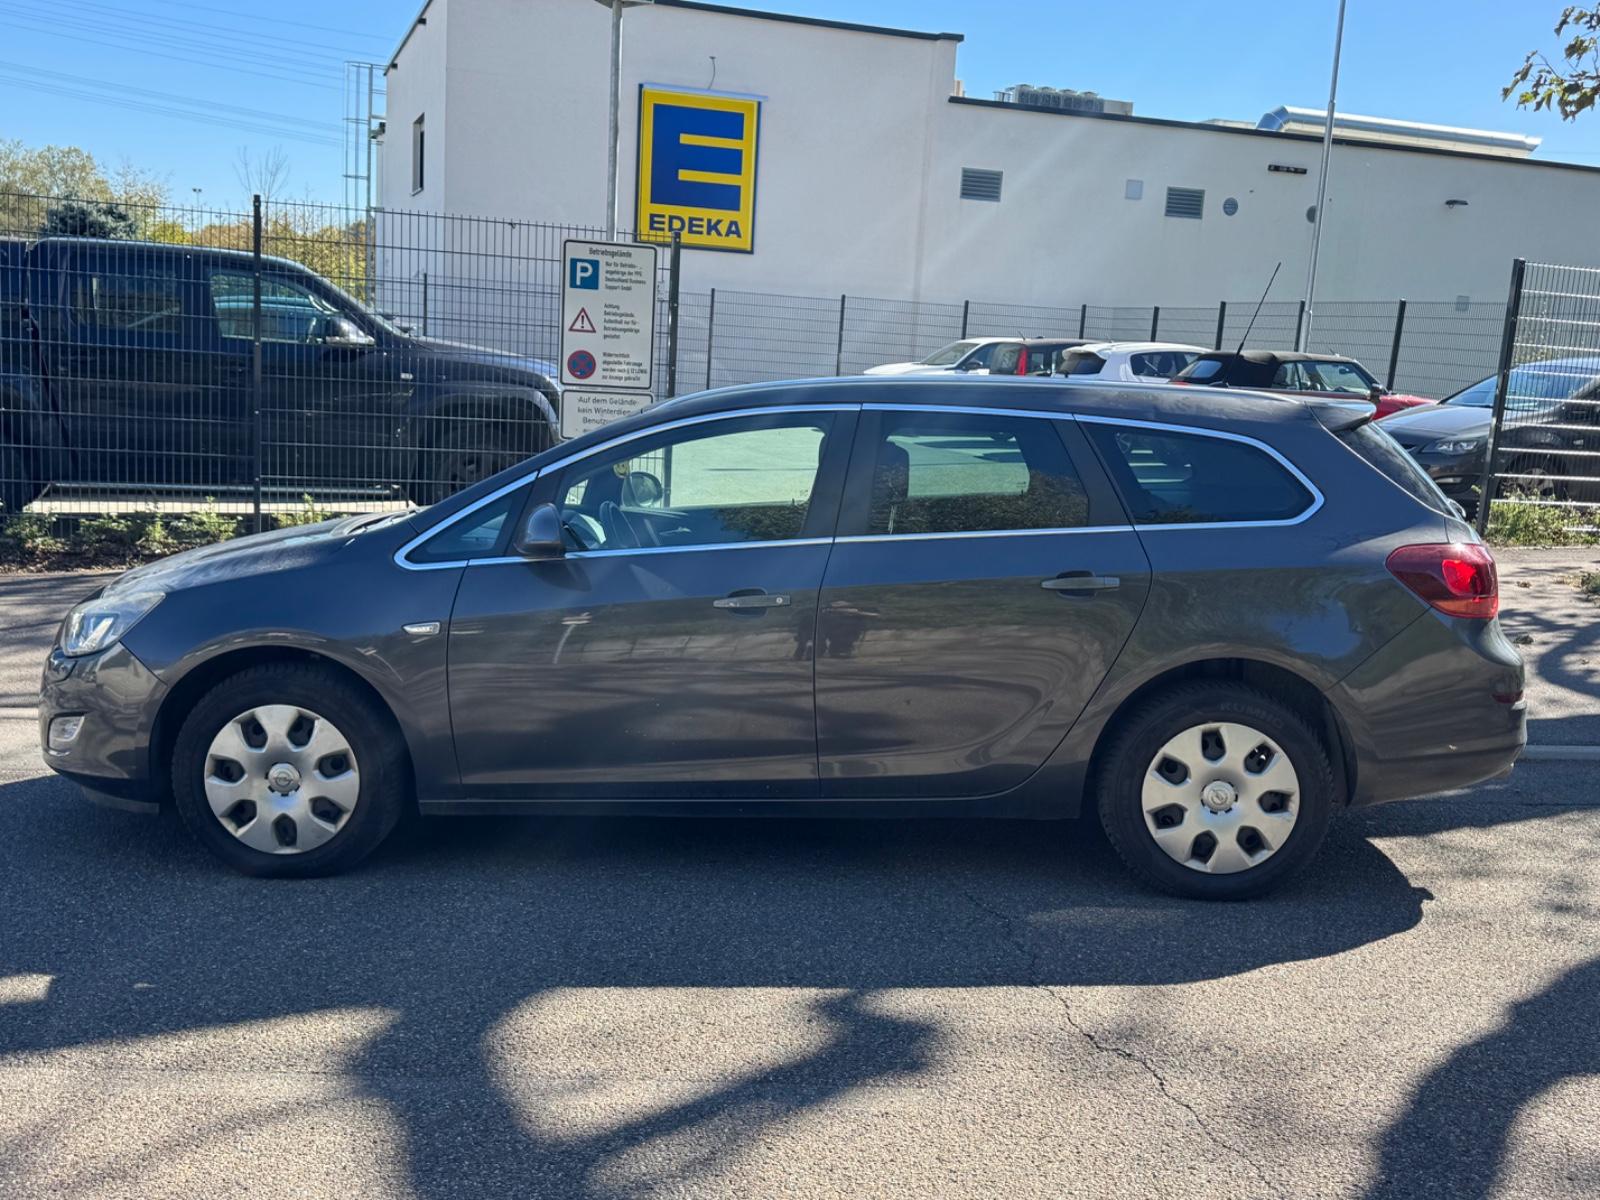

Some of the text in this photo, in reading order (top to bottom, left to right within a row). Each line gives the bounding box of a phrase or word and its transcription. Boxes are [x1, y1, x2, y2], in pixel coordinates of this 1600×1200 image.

[650, 103, 744, 212] E
[649, 213, 742, 239] EDEKA
[589, 247, 632, 258] Betriebsgelände
[576, 261, 593, 286] P
[592, 396, 607, 404] dem
